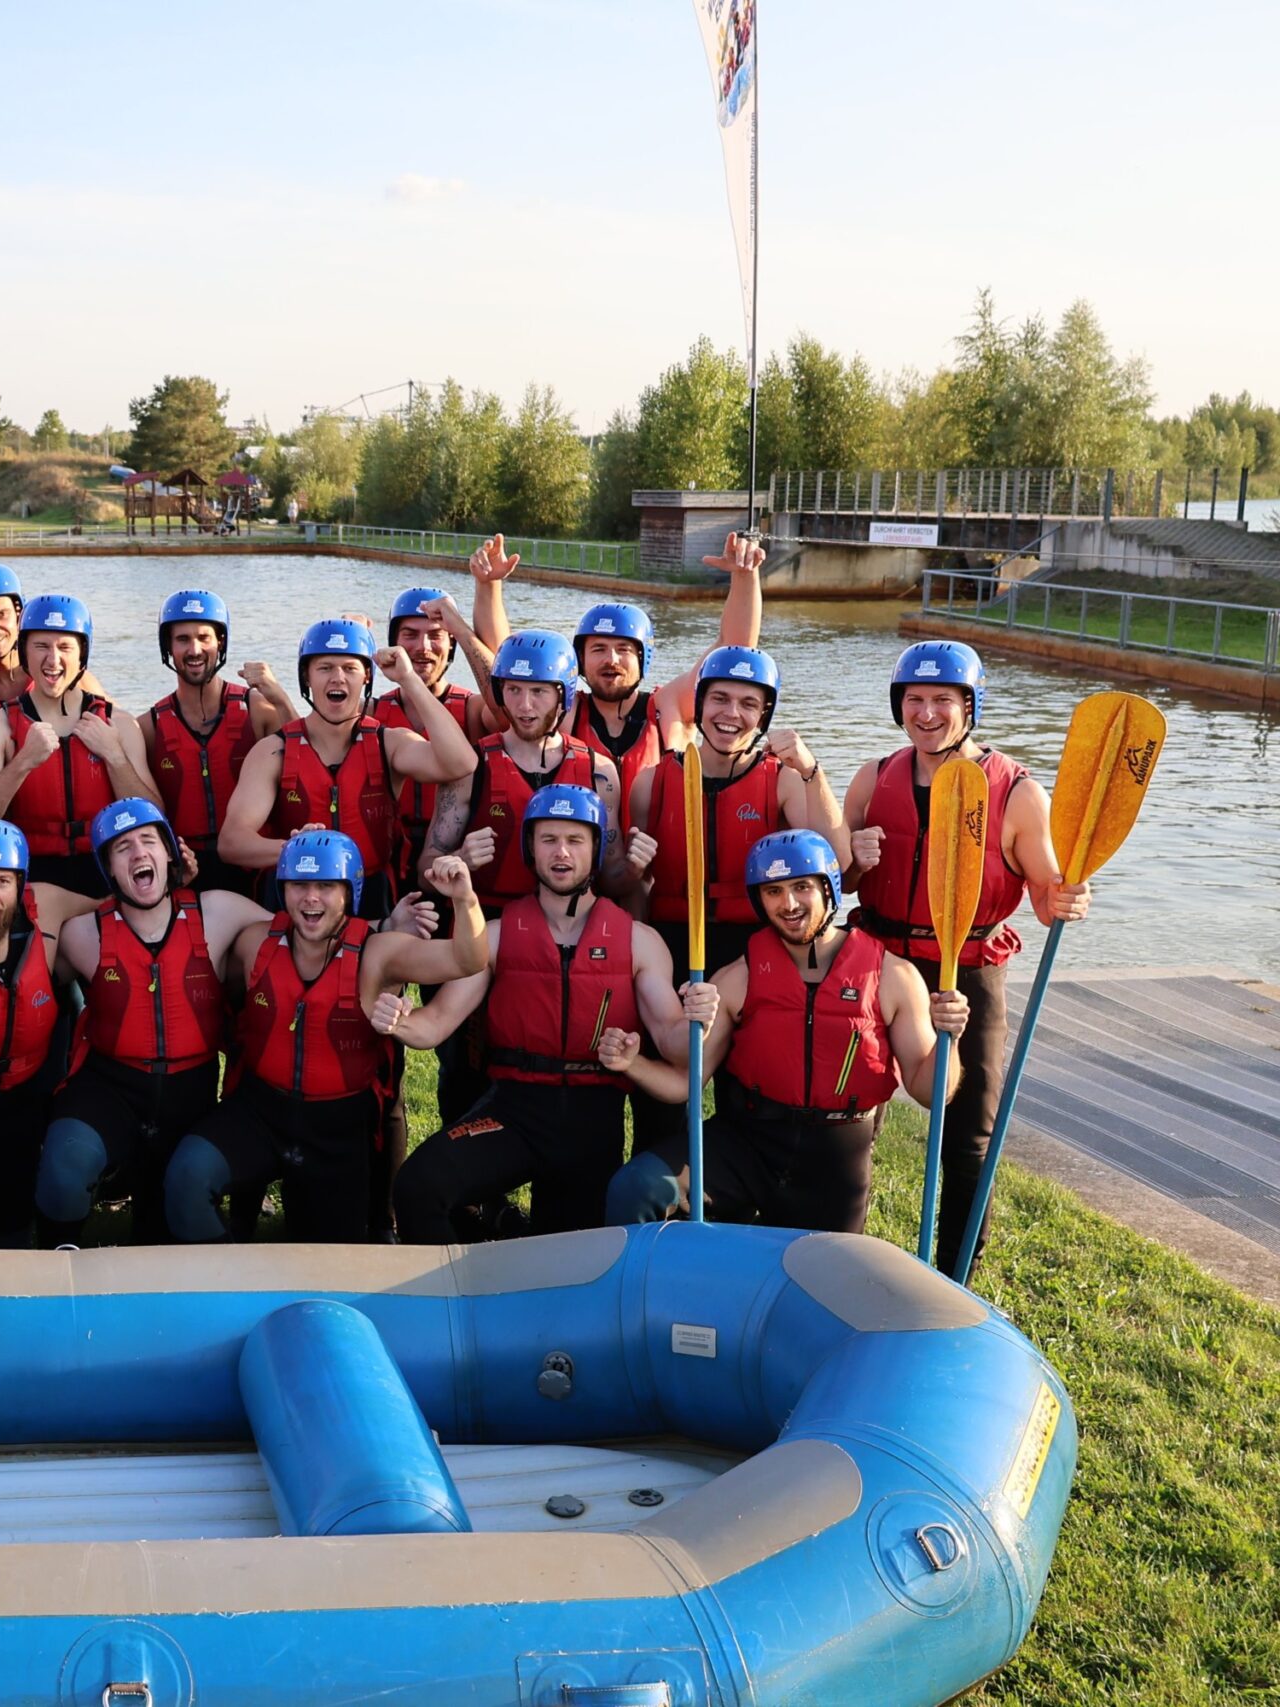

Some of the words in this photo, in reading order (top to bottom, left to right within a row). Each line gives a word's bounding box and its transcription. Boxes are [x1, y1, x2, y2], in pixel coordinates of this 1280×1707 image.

[873, 526, 906, 534] DURCHFAHRT
[907, 527, 933, 536] VERBOTEN
[1135, 739, 1158, 786] KANUPARK
[736, 803, 761, 822] Palm
[975, 799, 985, 847] KANUPARK
[518, 917, 528, 931] L
[602, 921, 612, 937] L
